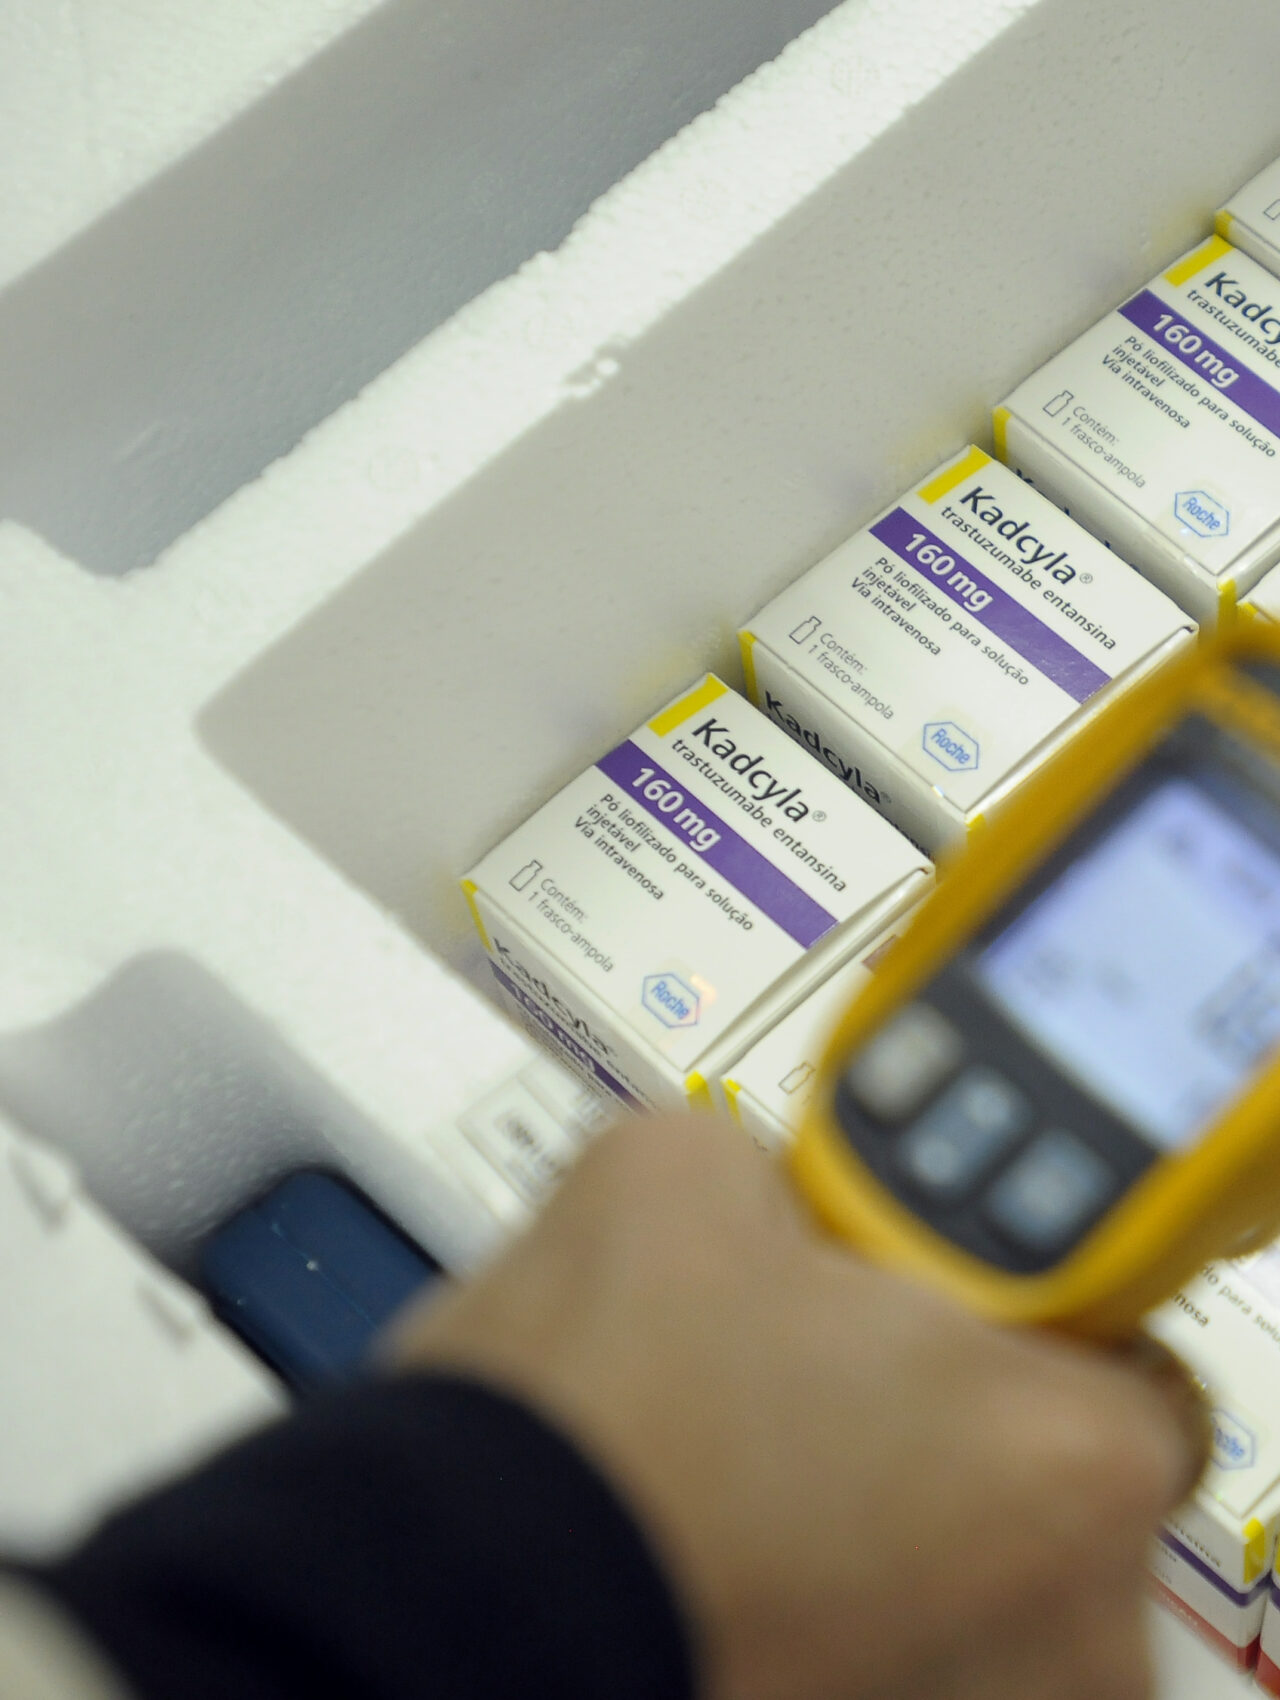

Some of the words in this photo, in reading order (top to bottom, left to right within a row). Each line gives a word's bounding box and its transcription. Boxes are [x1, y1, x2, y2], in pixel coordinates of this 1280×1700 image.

[1111, 344, 1166, 387] injetável
[1152, 313, 1203, 354] 160
[1193, 350, 1240, 388] mg
[1101, 354, 1121, 374] Via
[1120, 370, 1190, 429] intravenosa
[1123, 335, 1143, 351] Pó
[1141, 348, 1199, 397] liofilizado
[1197, 396, 1229, 420] para
[1228, 418, 1276, 457] solução
[1071, 424, 1148, 490] frasco-ampola
[1183, 496, 1222, 532] Roche
[862, 566, 917, 612] injetável
[904, 532, 956, 575] 160
[946, 571, 993, 612] mg
[941, 506, 1042, 590] trastuzumabe
[1043, 589, 1116, 650] entansina
[851, 577, 871, 599] Via
[871, 595, 941, 656] intravenosa
[875, 557, 895, 574] Pó
[892, 571, 951, 622] liofilizado
[948, 621, 981, 646] para
[981, 644, 1029, 685] solução
[817, 652, 895, 721] frasco-ampola
[932, 728, 972, 766] Roche
[585, 804, 642, 853] injetável
[632, 767, 684, 813] 160
[673, 808, 722, 852] mg
[672, 738, 773, 828] trastuzumabe
[773, 827, 847, 892] entansina
[574, 816, 595, 839] Via
[594, 835, 664, 901] intravenosa
[600, 794, 621, 812] Pó
[618, 808, 677, 864] liofilizado
[673, 862, 706, 890] para
[706, 887, 754, 931] solução
[536, 898, 614, 973] frasco-ampola
[650, 980, 691, 1021] Roche
